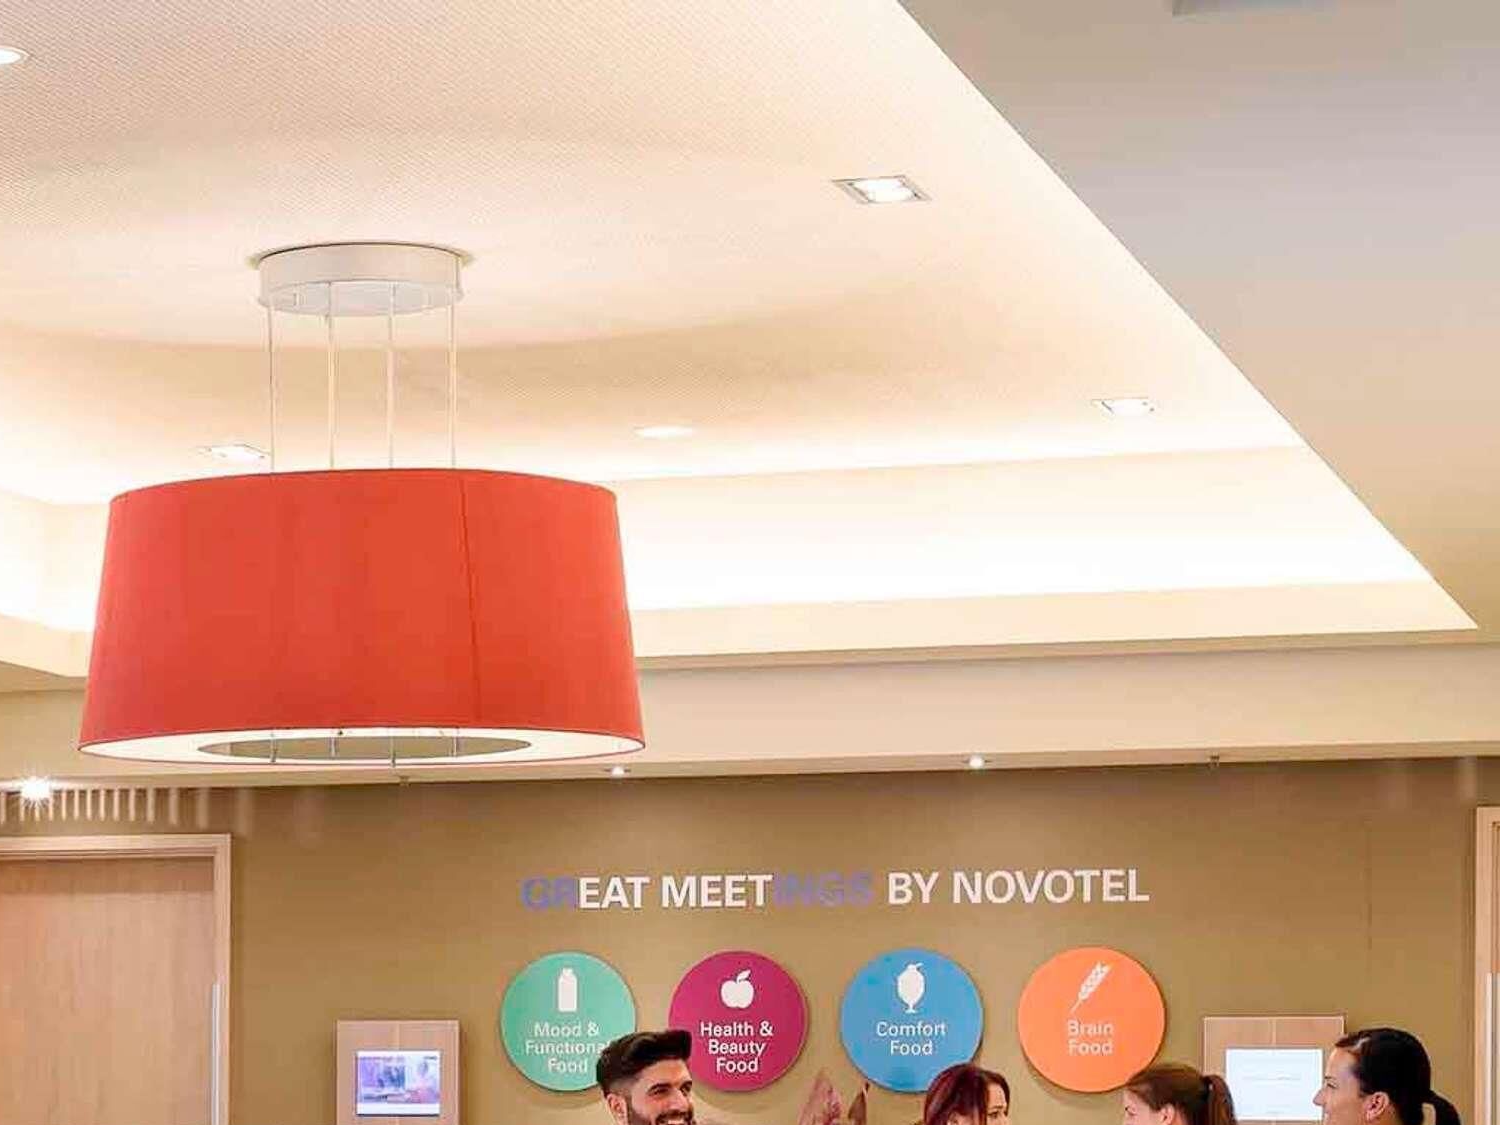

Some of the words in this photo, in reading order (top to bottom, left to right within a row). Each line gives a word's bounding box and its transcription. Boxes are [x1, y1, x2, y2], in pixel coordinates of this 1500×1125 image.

[887, 871, 940, 905] BY
[952, 868, 1150, 904] NOVOTEL
[533, 1021, 582, 1037] Mood
[587, 1021, 600, 1037] &
[700, 1021, 755, 1037] Health
[759, 1020, 774, 1037] &
[875, 1021, 947, 1037] Comfort
[1067, 1019, 1114, 1036] Brain
[708, 1038, 766, 1056] Beauty
[889, 1039, 934, 1055] Food
[1067, 1038, 1114, 1055] Food
[547, 1057, 588, 1073] Food
[716, 1057, 759, 1073] Food
